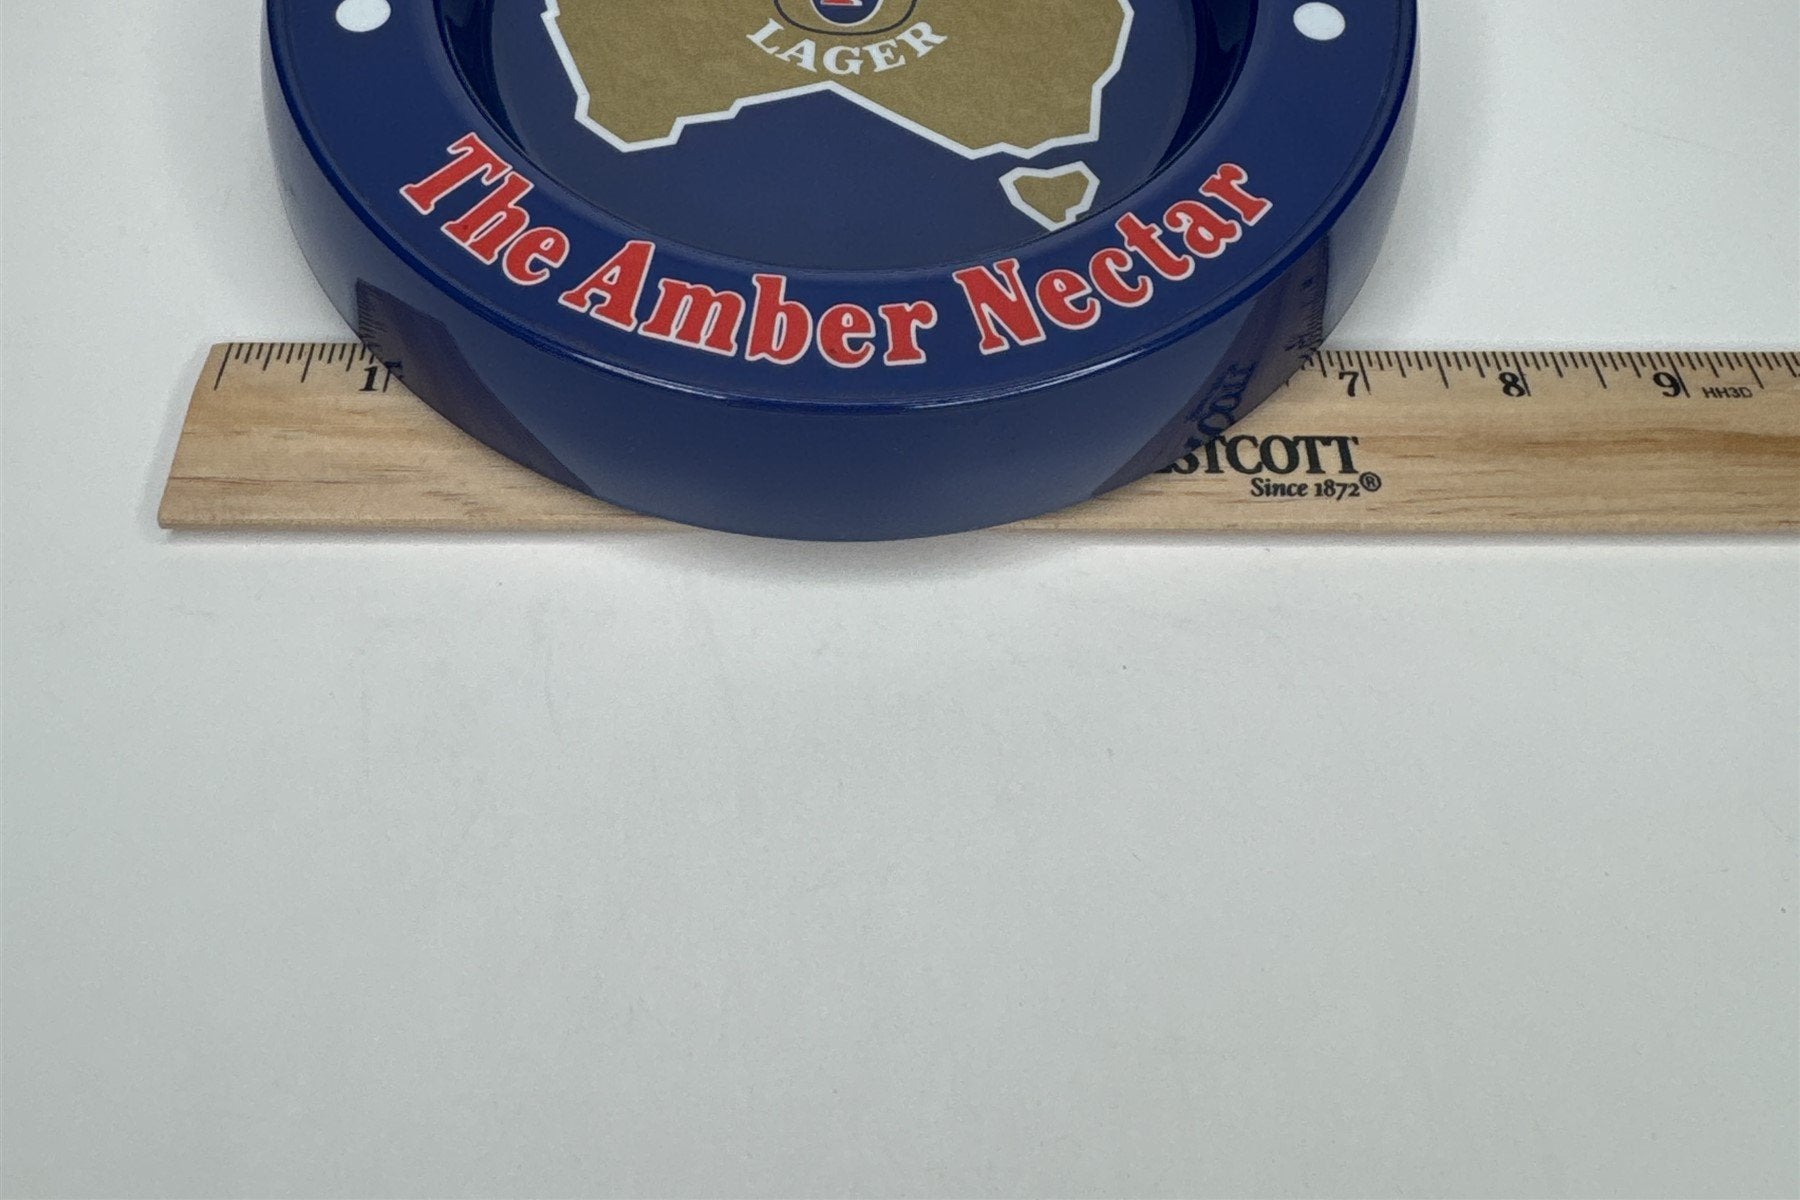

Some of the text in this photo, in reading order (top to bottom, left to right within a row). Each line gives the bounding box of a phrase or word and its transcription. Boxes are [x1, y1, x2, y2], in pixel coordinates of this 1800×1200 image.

[746, 17, 948, 75] LAGER
[399, 131, 1274, 369] The Amber Nectar
[359, 365, 379, 392] 1
[1338, 371, 1359, 397] 7
[1498, 371, 1526, 398] 8
[1652, 371, 1682, 398] 9
[1155, 434, 1360, 475] STCOTT
[1250, 477, 1308, 498] Since
